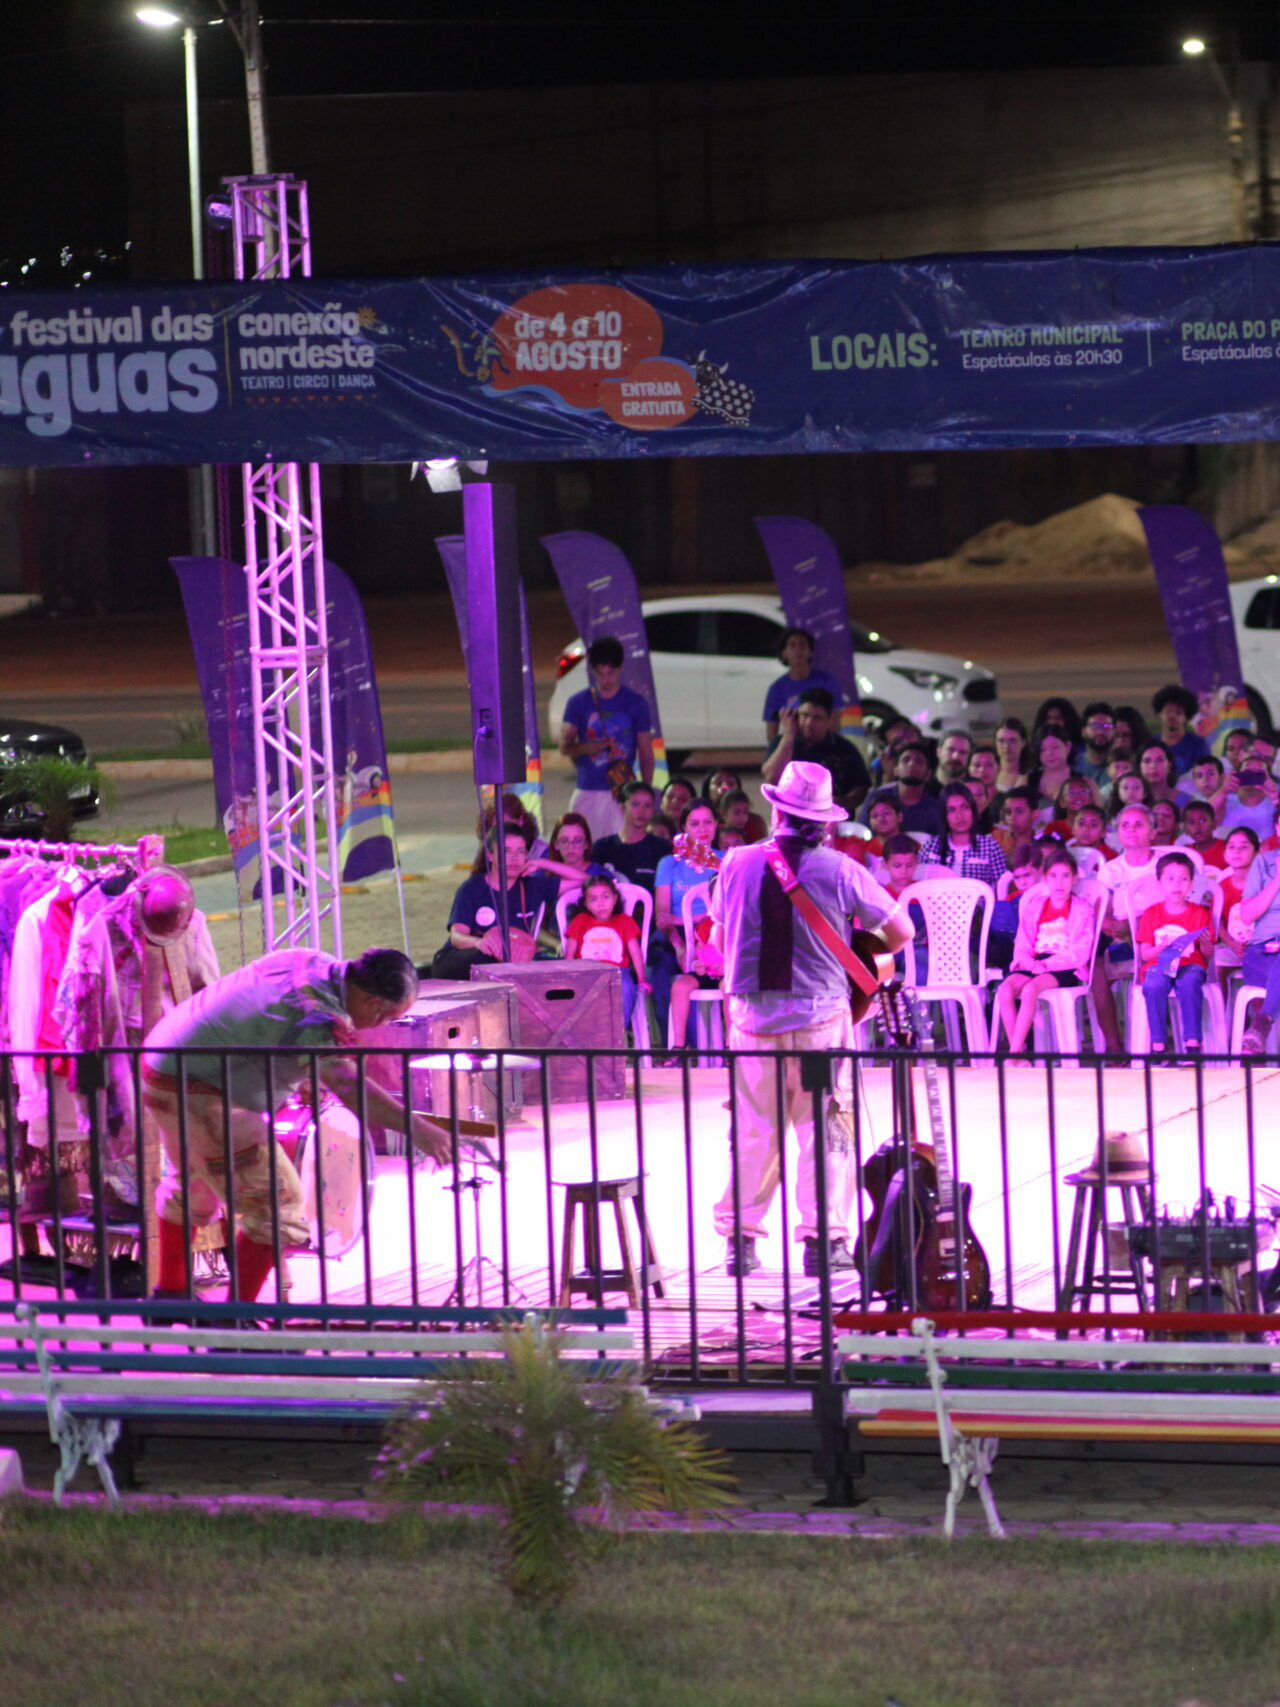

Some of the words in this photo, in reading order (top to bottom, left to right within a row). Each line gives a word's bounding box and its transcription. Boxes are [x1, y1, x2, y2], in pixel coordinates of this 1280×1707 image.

[10, 306, 143, 346] festival
[151, 307, 214, 343] das
[238, 302, 360, 337] conexão
[514, 313, 544, 338] de
[551, 312, 567, 337] 4
[572, 321, 588, 338] a
[597, 311, 622, 337] 10
[1182, 320, 1238, 343] PRAÇA
[1242, 319, 1266, 338] DO
[961, 328, 1025, 348] TEATRO
[1030, 325, 1123, 346] MUNICIPAL
[239, 338, 375, 370] nordeste
[515, 340, 622, 371] AGOSTO
[810, 333, 938, 370] LOCAIS:
[962, 352, 1050, 372] Espetáculos
[1054, 350, 1072, 366] às
[1076, 348, 1122, 365] 20h30
[1182, 344, 1272, 363] Espetáculos
[241, 375, 284, 390] TEATRO
[293, 374, 329, 389] CIRCO
[338, 373, 375, 389] DANÇA
[621, 382, 681, 397] ENTRADA
[622, 400, 686, 416] GRATUITA
